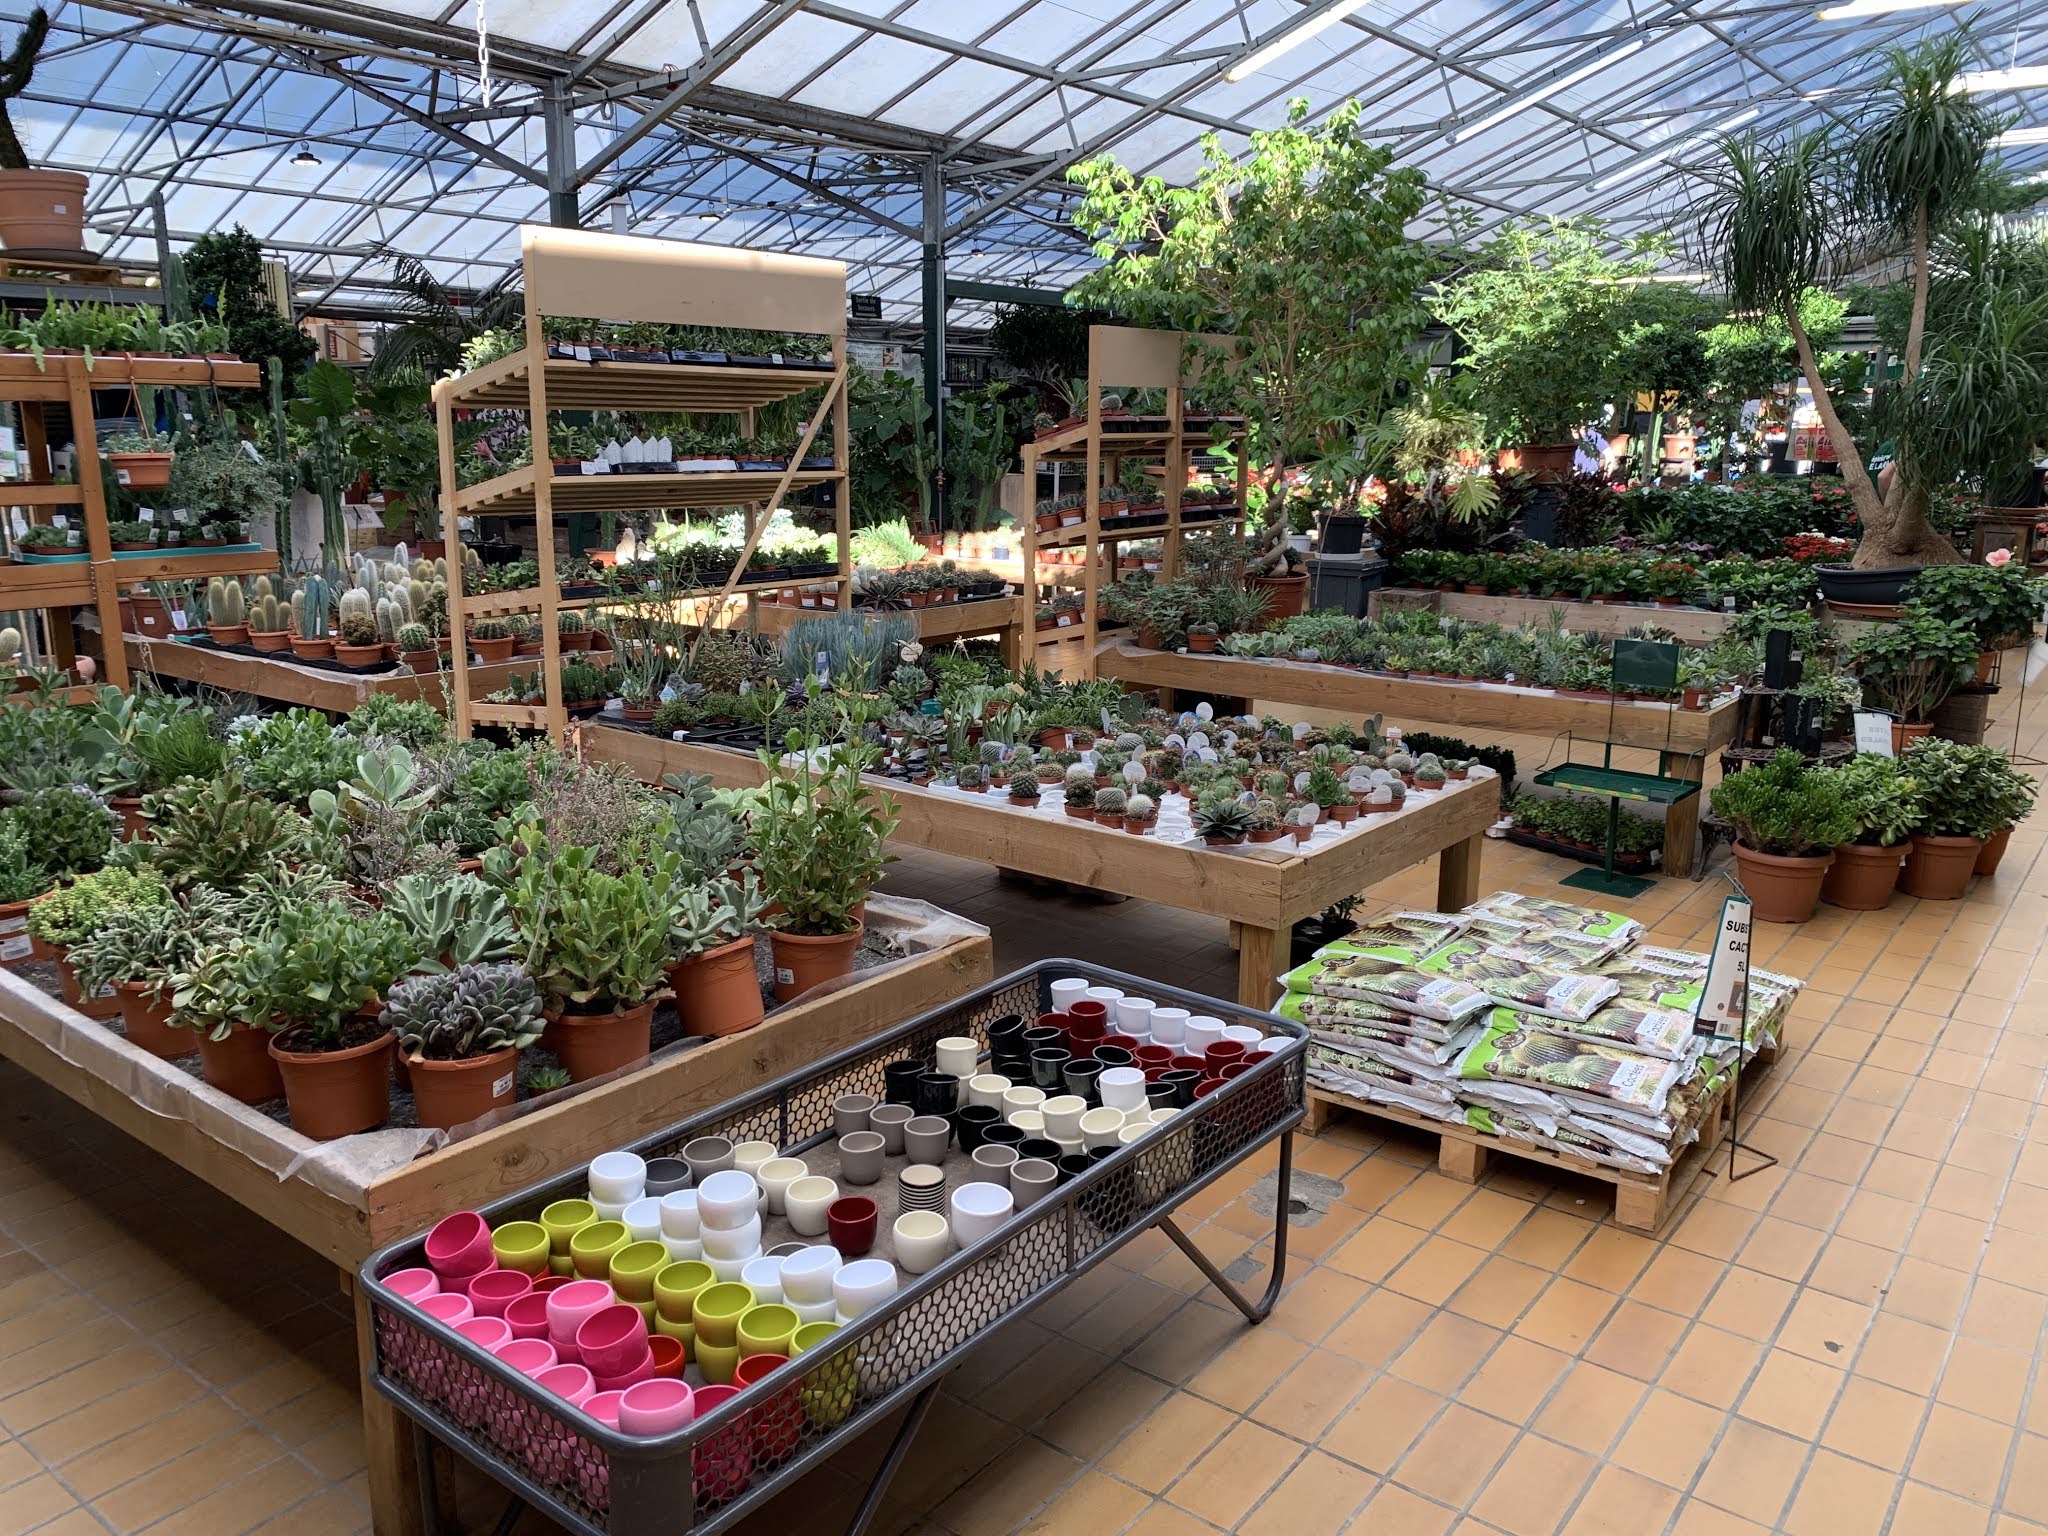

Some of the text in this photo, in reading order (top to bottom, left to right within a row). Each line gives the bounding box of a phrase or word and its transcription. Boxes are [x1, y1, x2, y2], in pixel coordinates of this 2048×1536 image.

[1361, 980, 1400, 994] Cactées
[1490, 984, 1528, 1000] Cactées
[1353, 1004, 1393, 1019] Cactées
[1574, 1021, 1618, 1037] Cactées
[1357, 1058, 1395, 1077] Cactées
[1546, 1071, 1591, 1090] Cactées
[1557, 1129, 1592, 1146] actées
